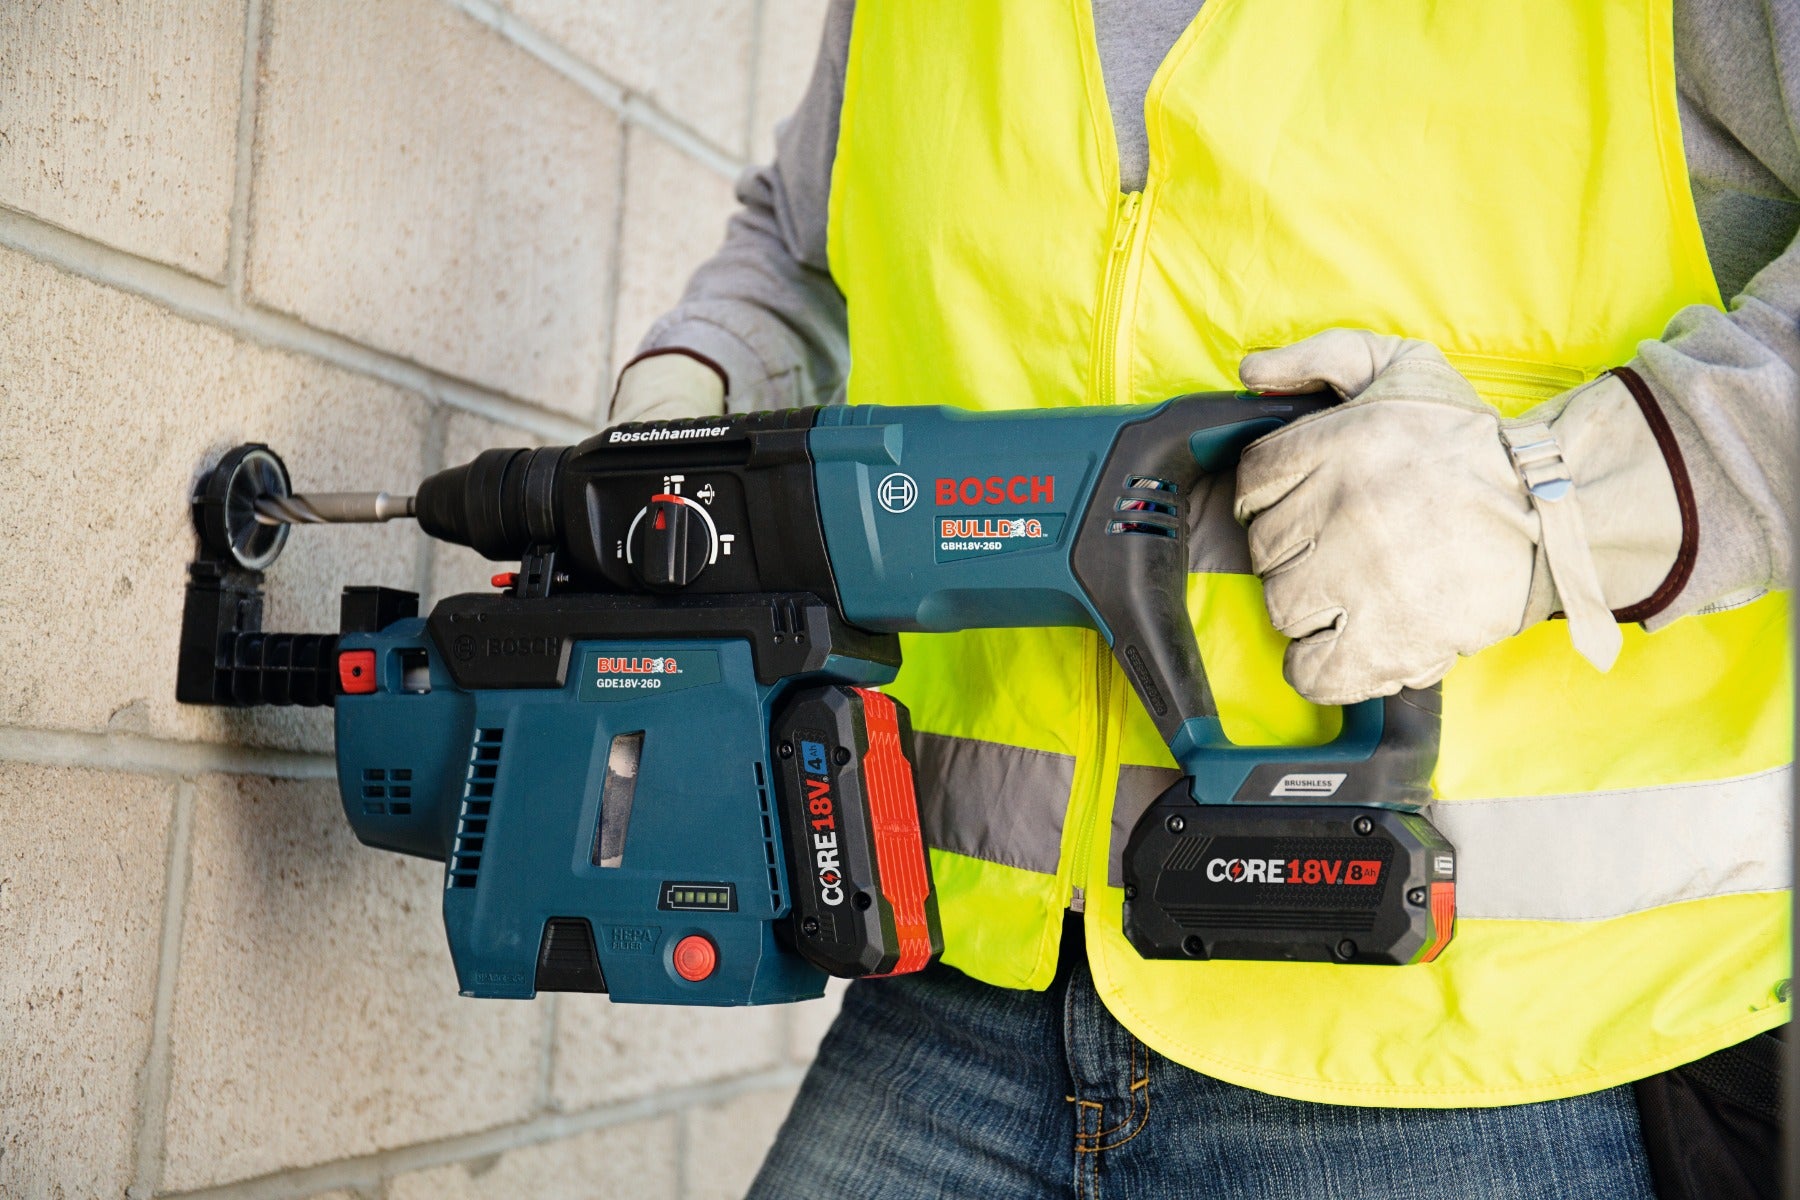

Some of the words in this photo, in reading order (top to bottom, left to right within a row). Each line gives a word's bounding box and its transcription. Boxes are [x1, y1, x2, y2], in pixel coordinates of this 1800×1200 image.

[608, 426, 730, 443] Boschhammer
[935, 475, 1055, 506] BOSCH
[940, 519, 1042, 538] BULLDG
[941, 541, 1002, 551] GBH18V-26D
[597, 657, 677, 674] BULLDG
[596, 678, 662, 689] GDE18V-26D
[612, 927, 652, 942] HEPA
